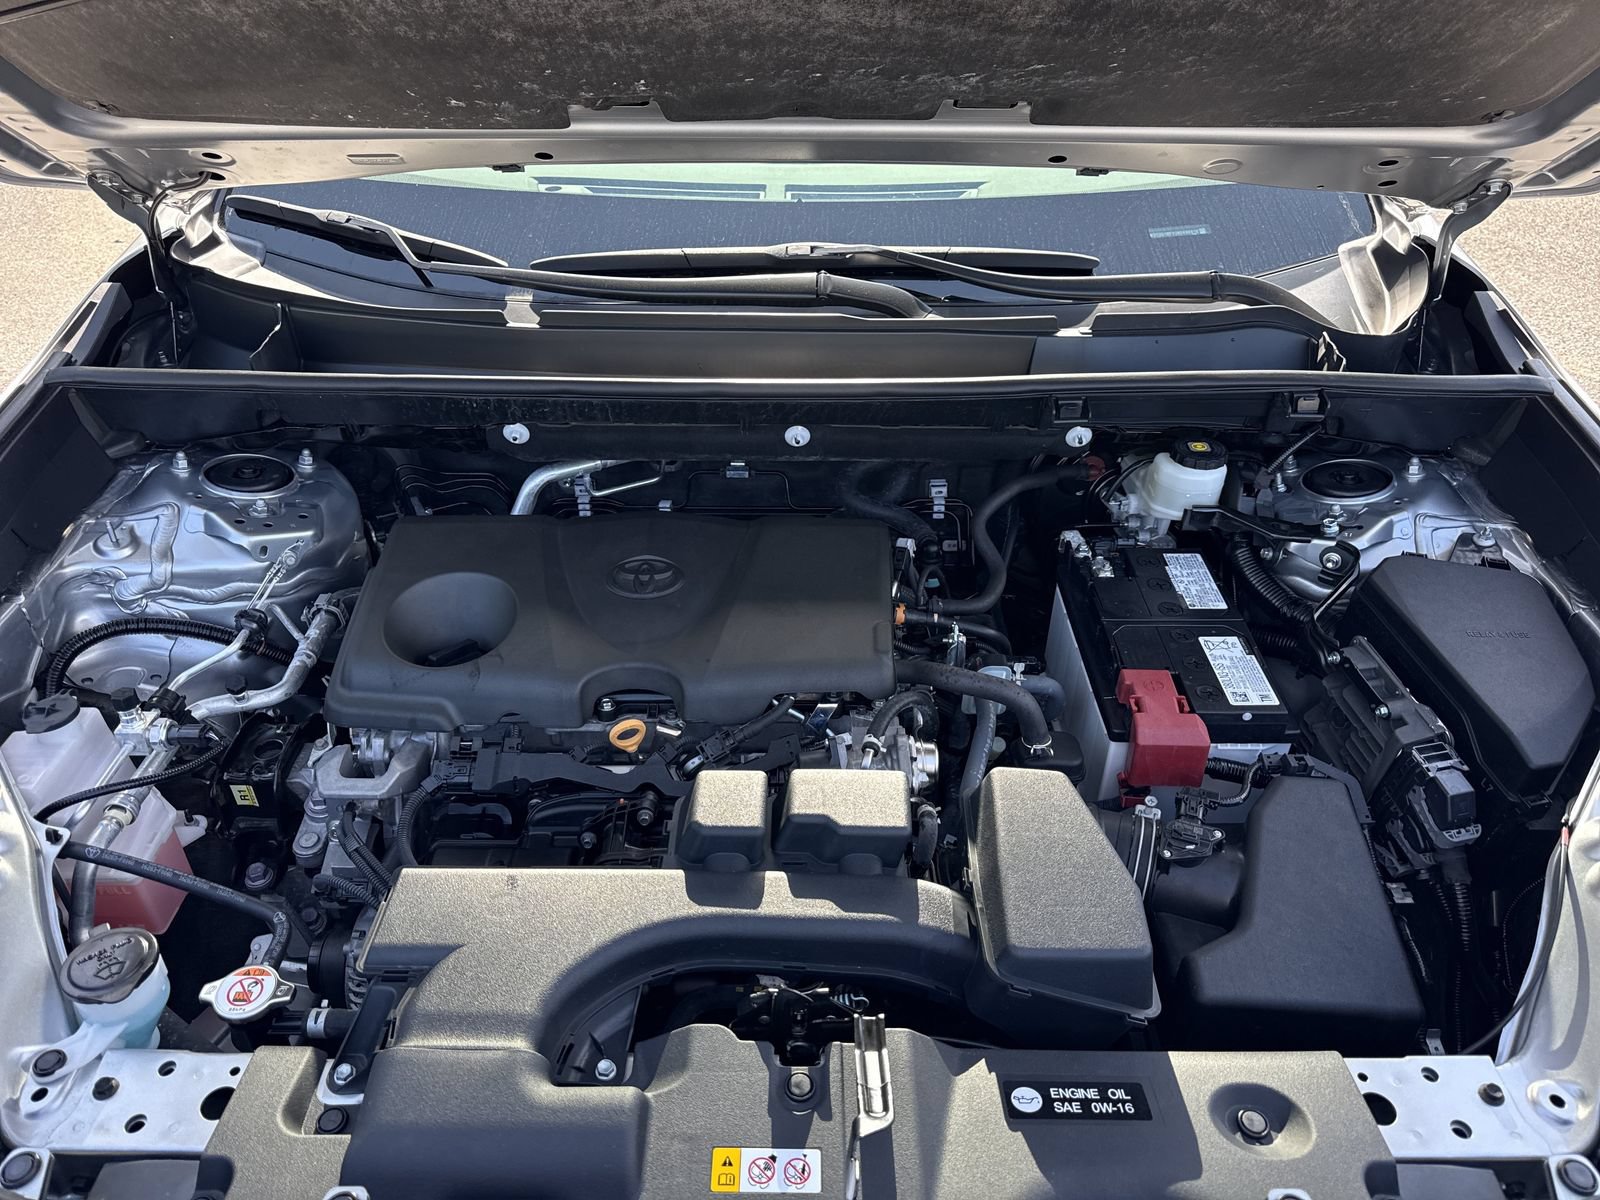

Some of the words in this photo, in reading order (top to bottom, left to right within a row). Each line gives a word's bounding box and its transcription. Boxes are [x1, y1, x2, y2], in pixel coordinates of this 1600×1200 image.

[1505, 631, 1531, 639] FUSE
[1049, 1088, 1100, 1099] ENGINE
[1107, 1088, 1131, 1099] OIL
[1053, 1101, 1083, 1113] SAE
[1090, 1102, 1135, 1114] 0W-16
